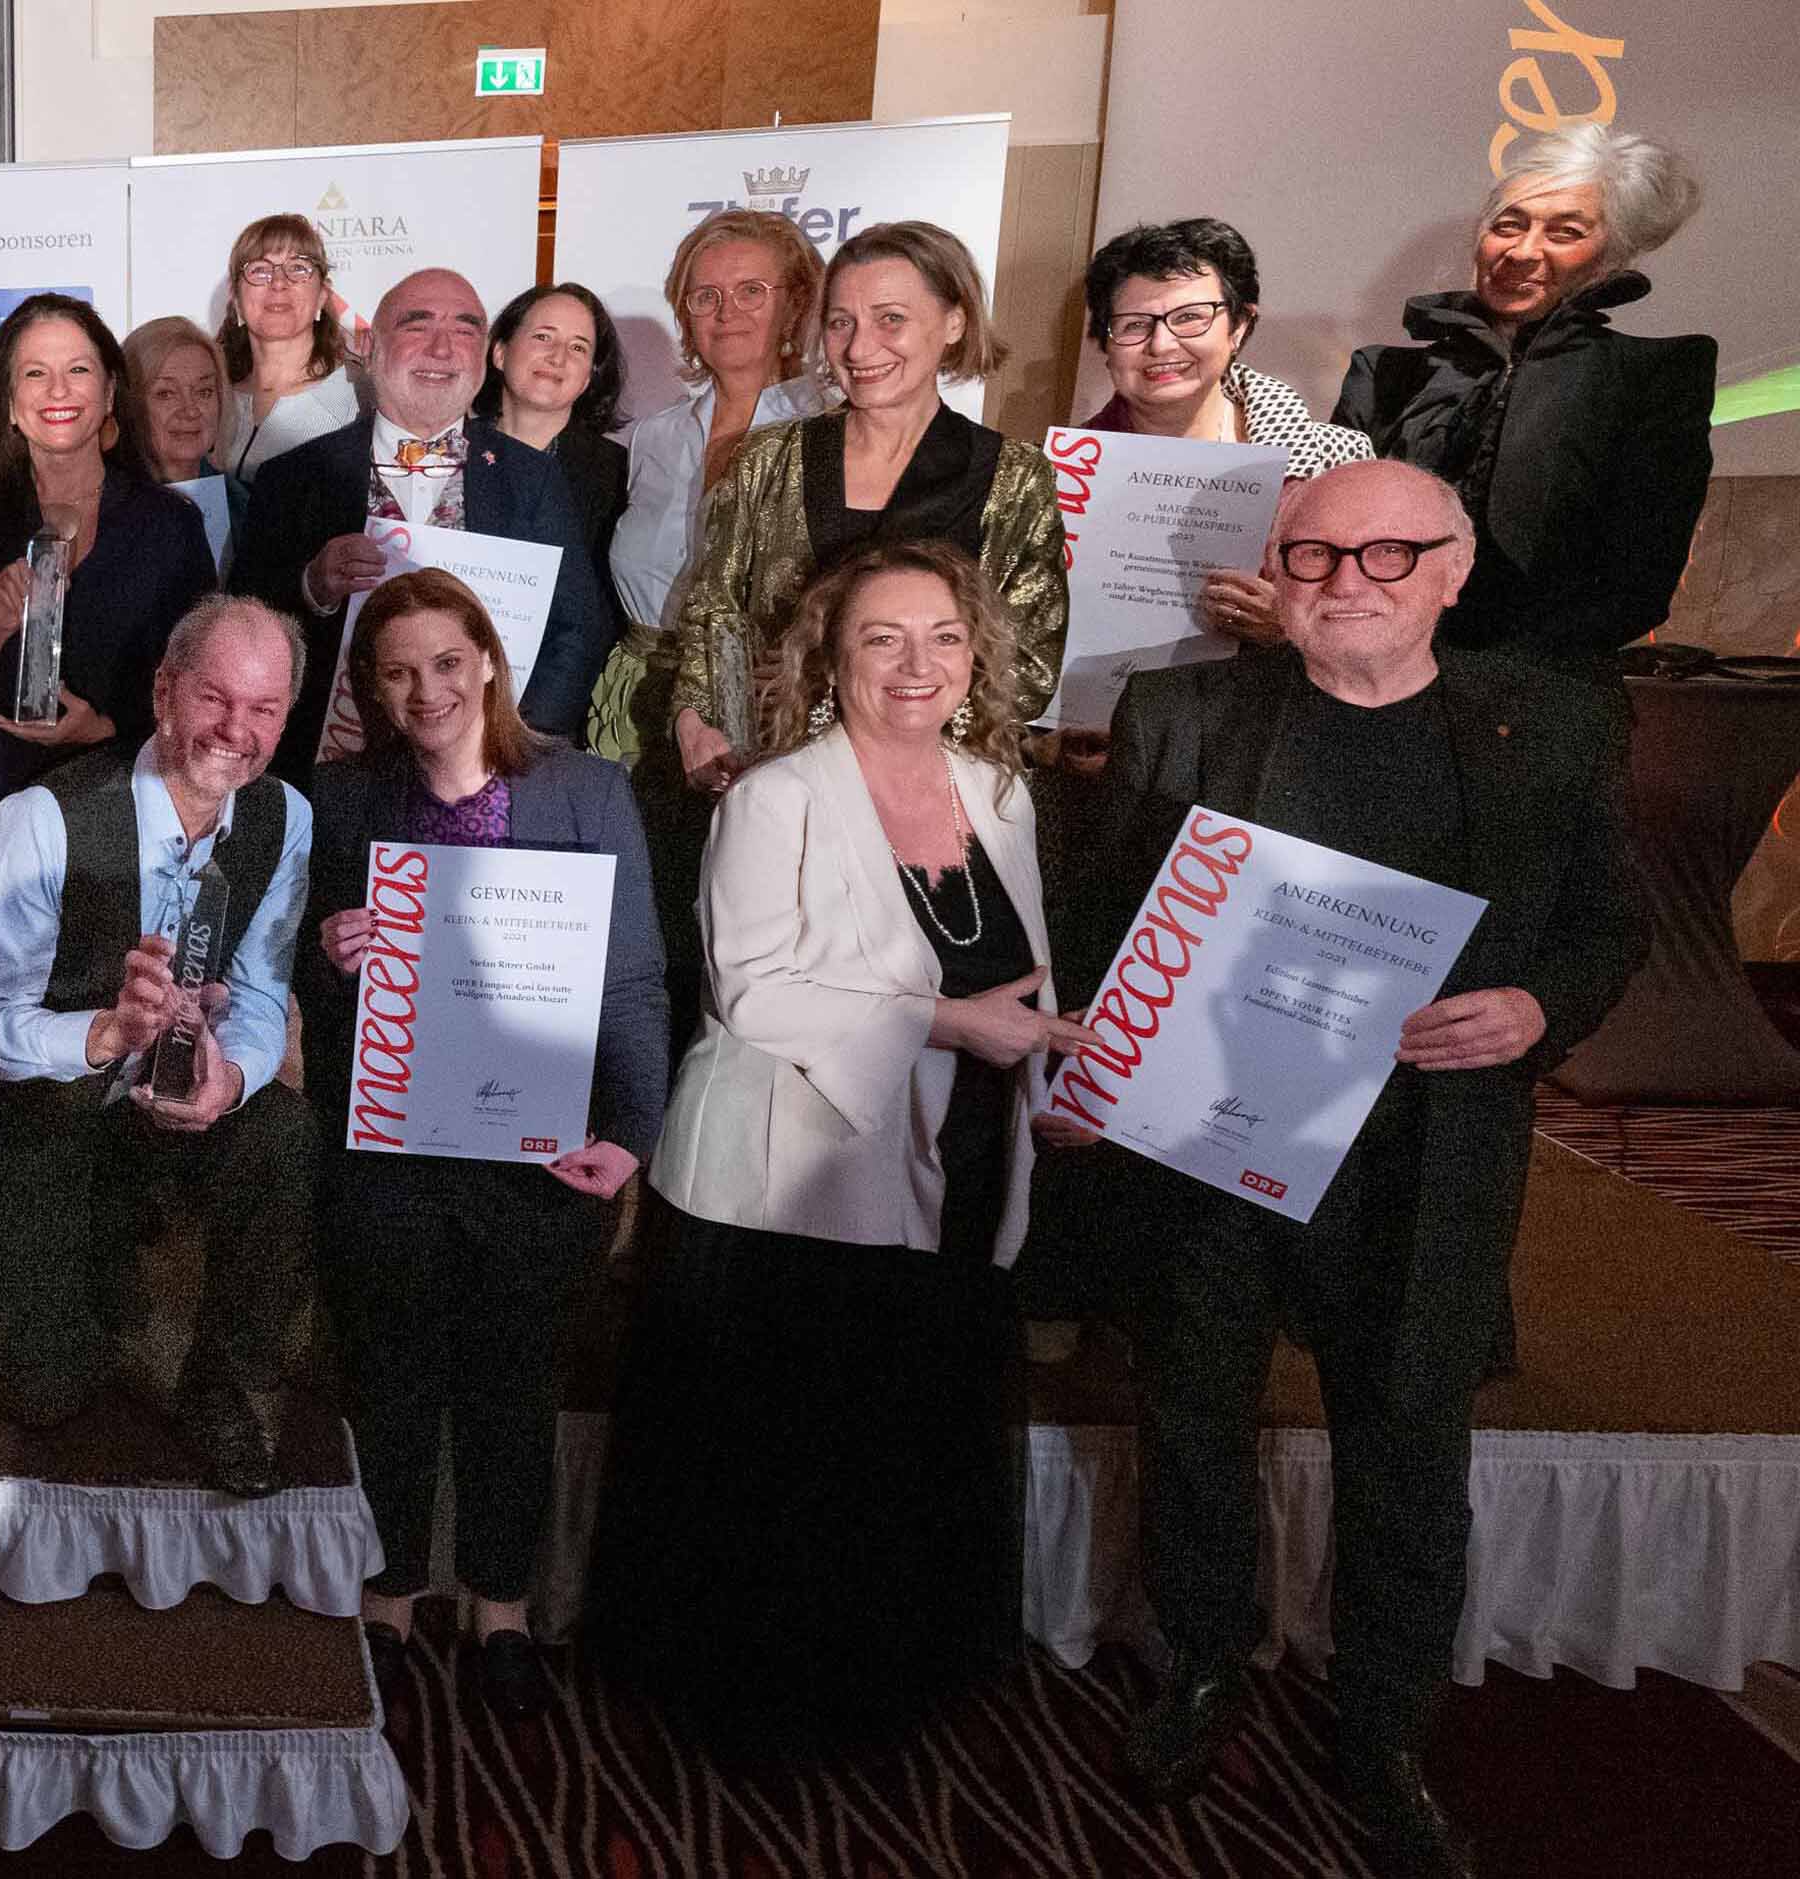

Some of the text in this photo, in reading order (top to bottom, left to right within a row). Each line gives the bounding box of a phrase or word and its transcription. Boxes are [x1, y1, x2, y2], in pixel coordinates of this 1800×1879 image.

[1128, 471, 1262, 496] ANERKENNUNG
[471, 886, 564, 904] GEWINNER
[1273, 881, 1439, 945] ANERKENNUNG
[1312, 926, 1432, 977] MITTELBETRIEBE
[523, 1140, 557, 1152] ORF
[1243, 1173, 1286, 1198] ORF
